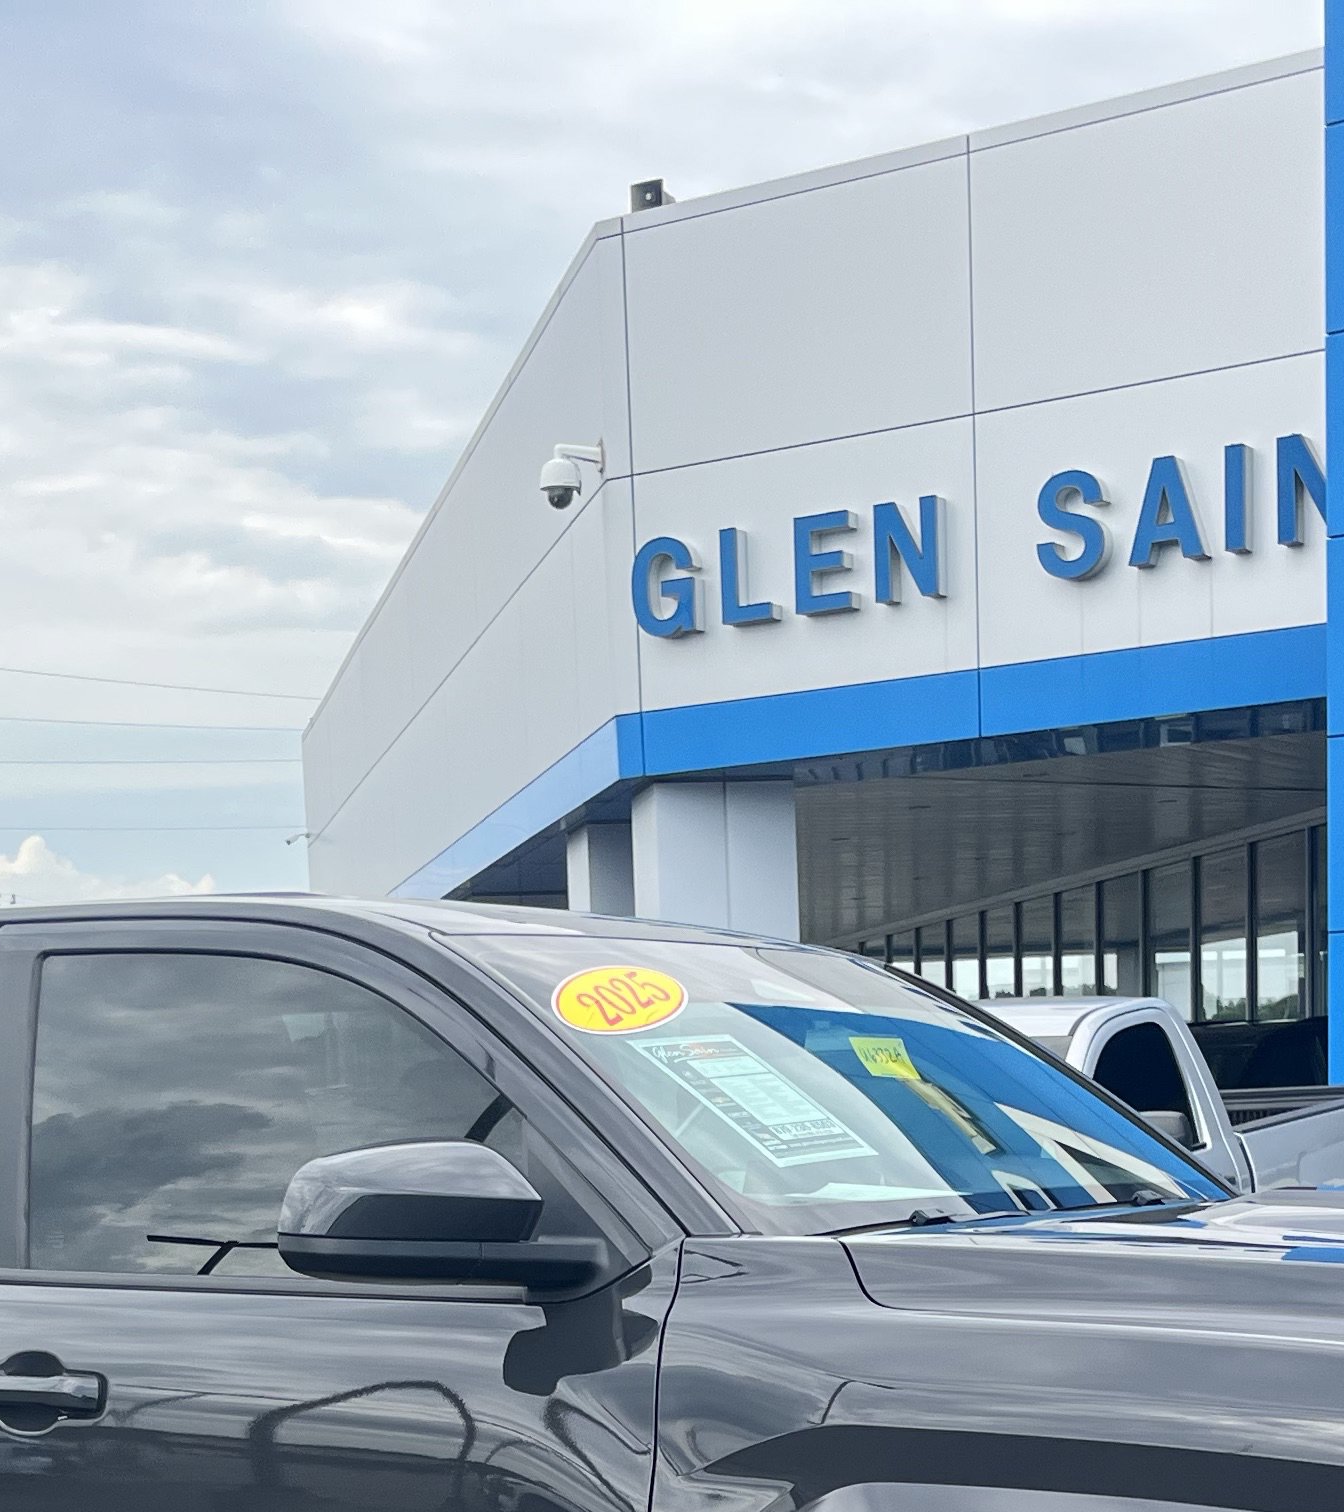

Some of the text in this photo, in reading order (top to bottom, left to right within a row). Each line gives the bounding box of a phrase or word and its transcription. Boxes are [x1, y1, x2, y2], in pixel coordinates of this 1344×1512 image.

[631, 433, 1328, 639] GLEN SAIN
[576, 971, 671, 1026] 2025
